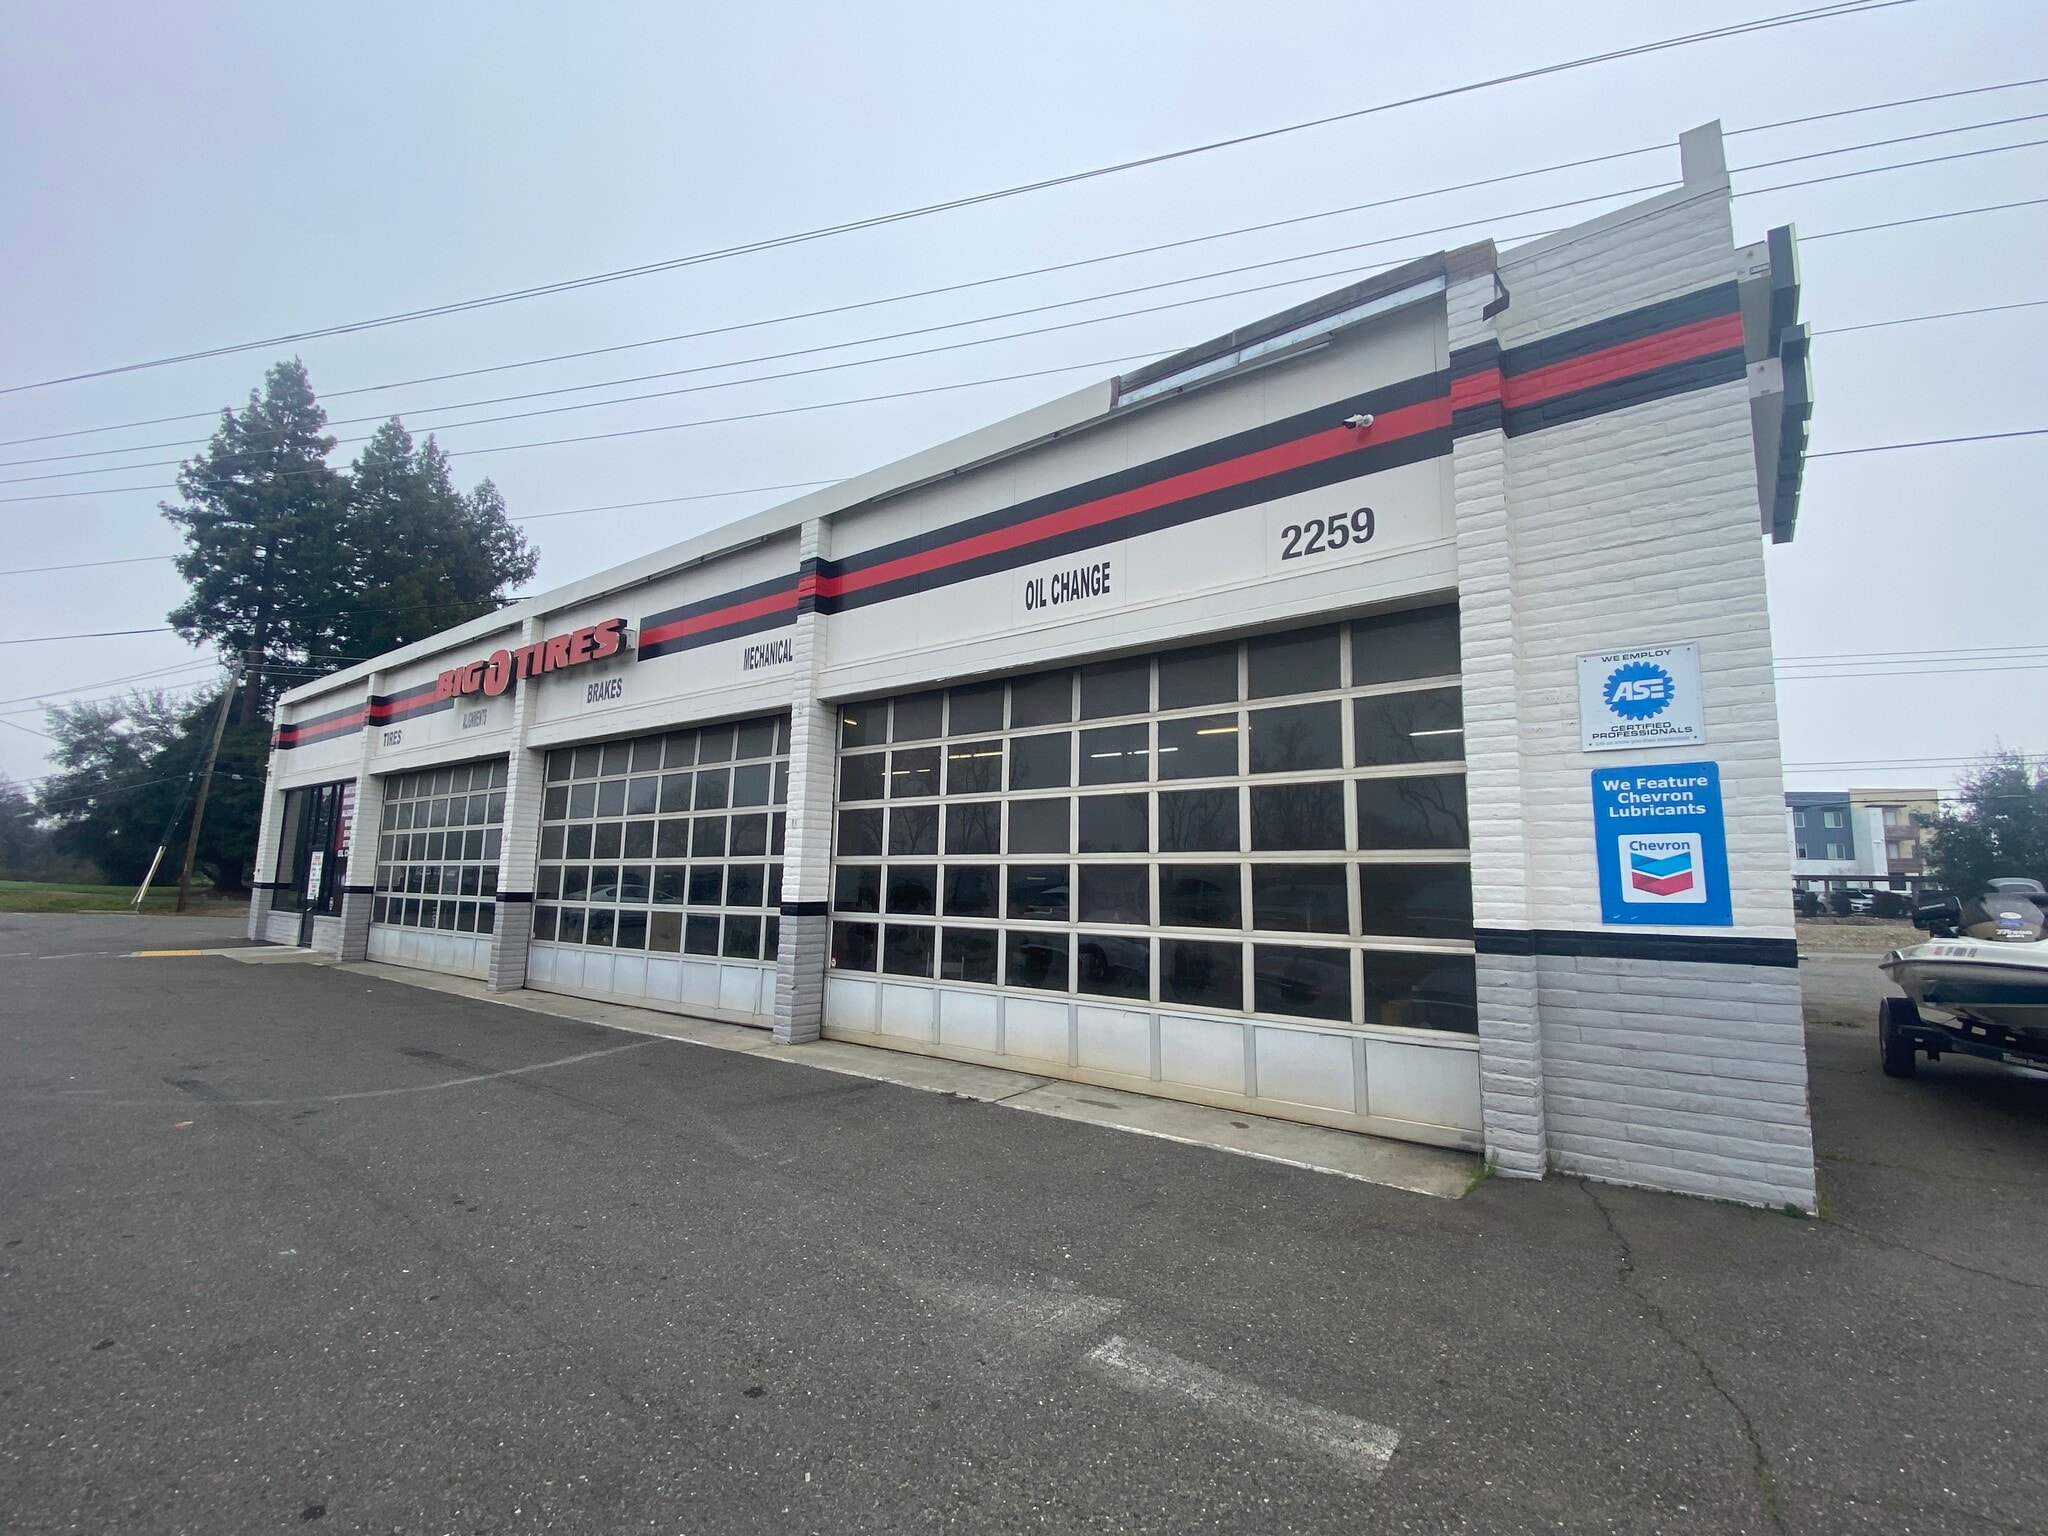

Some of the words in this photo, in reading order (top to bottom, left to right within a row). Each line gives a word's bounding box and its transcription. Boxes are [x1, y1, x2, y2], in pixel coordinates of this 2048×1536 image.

[1281, 507, 1375, 560] 2259
[1025, 579, 1047, 611] OIL
[1051, 562, 1111, 605] CHANGE
[435, 660, 488, 701] BIG
[484, 650, 515, 697] O
[515, 618, 628, 680] TIRES
[743, 638, 793, 671] MECHANICAL
[1601, 655, 1620, 663] WE
[1622, 649, 1672, 661] EMPLOY
[587, 677, 623, 704] BRAKES
[1612, 678, 1665, 703] ASE
[1592, 726, 1693, 739] PROFESSIONALS
[1611, 721, 1672, 732] CERTIFIED
[383, 729, 402, 747] TIRES
[1603, 778, 1631, 791] We
[1636, 775, 1708, 790] Feature
[1617, 790, 1694, 804] Chevron
[1608, 802, 1706, 818] Lubricants
[1629, 840, 1691, 851] Chevron
